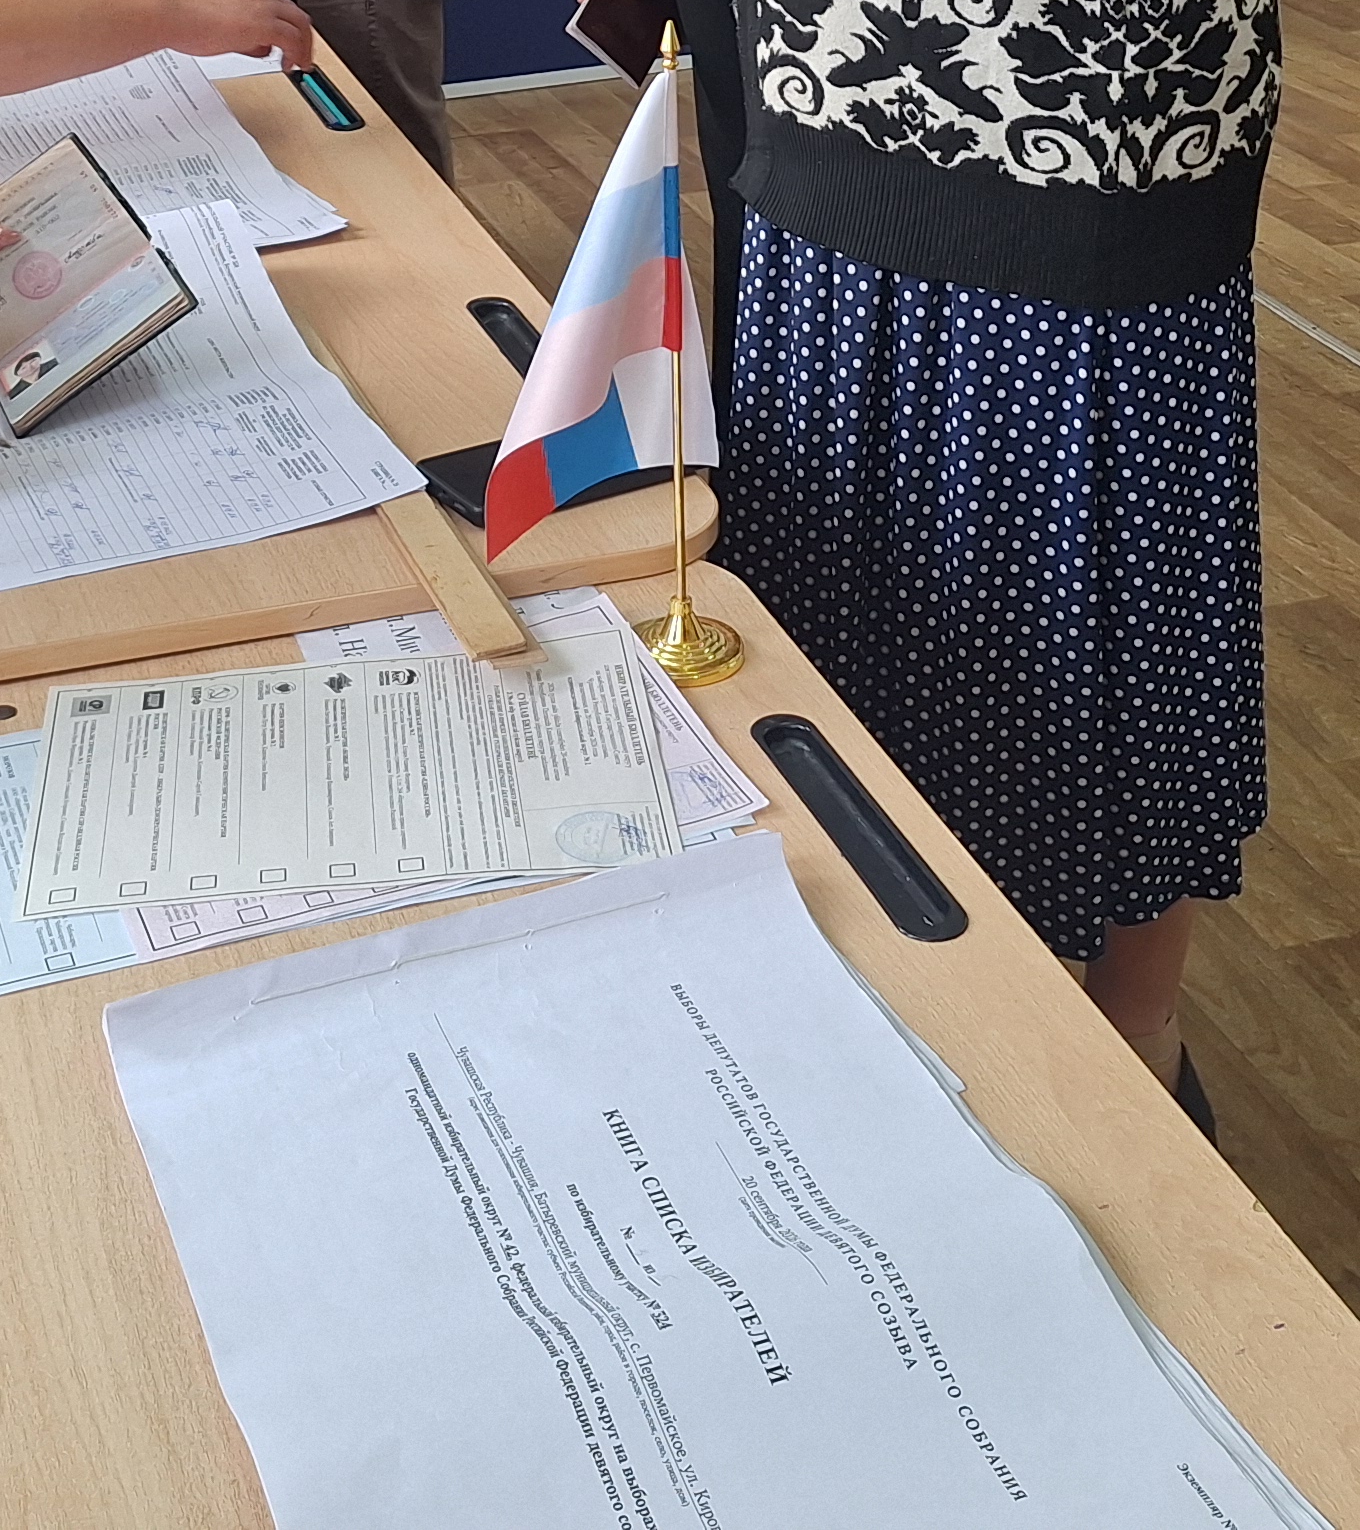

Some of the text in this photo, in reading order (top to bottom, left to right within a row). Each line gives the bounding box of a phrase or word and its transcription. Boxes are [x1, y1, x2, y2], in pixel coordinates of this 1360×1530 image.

[614, 664, 645, 765] ИЗБИРАТЕЛЬНЫЙ БЮЛЛЕТЕНЬ
[407, 1052, 452, 1121] одномандатный
[477, 1091, 515, 1143] Республика
[443, 1122, 490, 1195] избирательный
[511, 1145, 542, 1192] Чувашия,
[741, 1176, 758, 1189] 20
[481, 1195, 502, 1226] округ
[563, 1183, 582, 1197] по
[747, 1191, 786, 1232] сентября
[496, 1227, 513, 1244] №
[534, 1191, 577, 1260] Батыревский
[572, 1197, 630, 1281] избирательному
[704, 1066, 922, 1373] РОССИЙСКОЙ ФЕДЕРАЦИИ ДЕВЯТОГО СОЗЫВА
[501, 1240, 519, 1261] 42,
[602, 1104, 797, 1389] КНИГА СПИСКА ИЗБИРАТЕЛЕЙ
[670, 984, 1028, 1505] ВЫБОРЫ ДЕПУТАТОВ ГОСУДАРСТВЕННОЙ ДУМЫ ФЕДЕРАЛЬНОГО СОБРАНИЯ
[405, 1088, 454, 1164] Государственной
[441, 1164, 469, 1195] Думы
[460, 1196, 505, 1273] Федерального
[493, 1272, 529, 1318] Собрания
[522, 1316, 563, 1358] Российской
[556, 1359, 600, 1439] Федерации
[585, 1438, 627, 1515] девятого
[510, 1263, 558, 1318] федеральный
[644, 1300, 661, 1314] №
[611, 1313, 636, 1341] округ,
[630, 1340, 644, 1353] с.
[650, 1310, 676, 1334] 324
[548, 1316, 604, 1394] избирательный
[591, 1396, 623, 1443] округ
[636, 1354, 692, 1462] Первомайское,
[613, 1443, 628, 1467] на
[680, 1464, 702, 1489] ул.
[1177, 1463, 1224, 1518] Экземпляр
